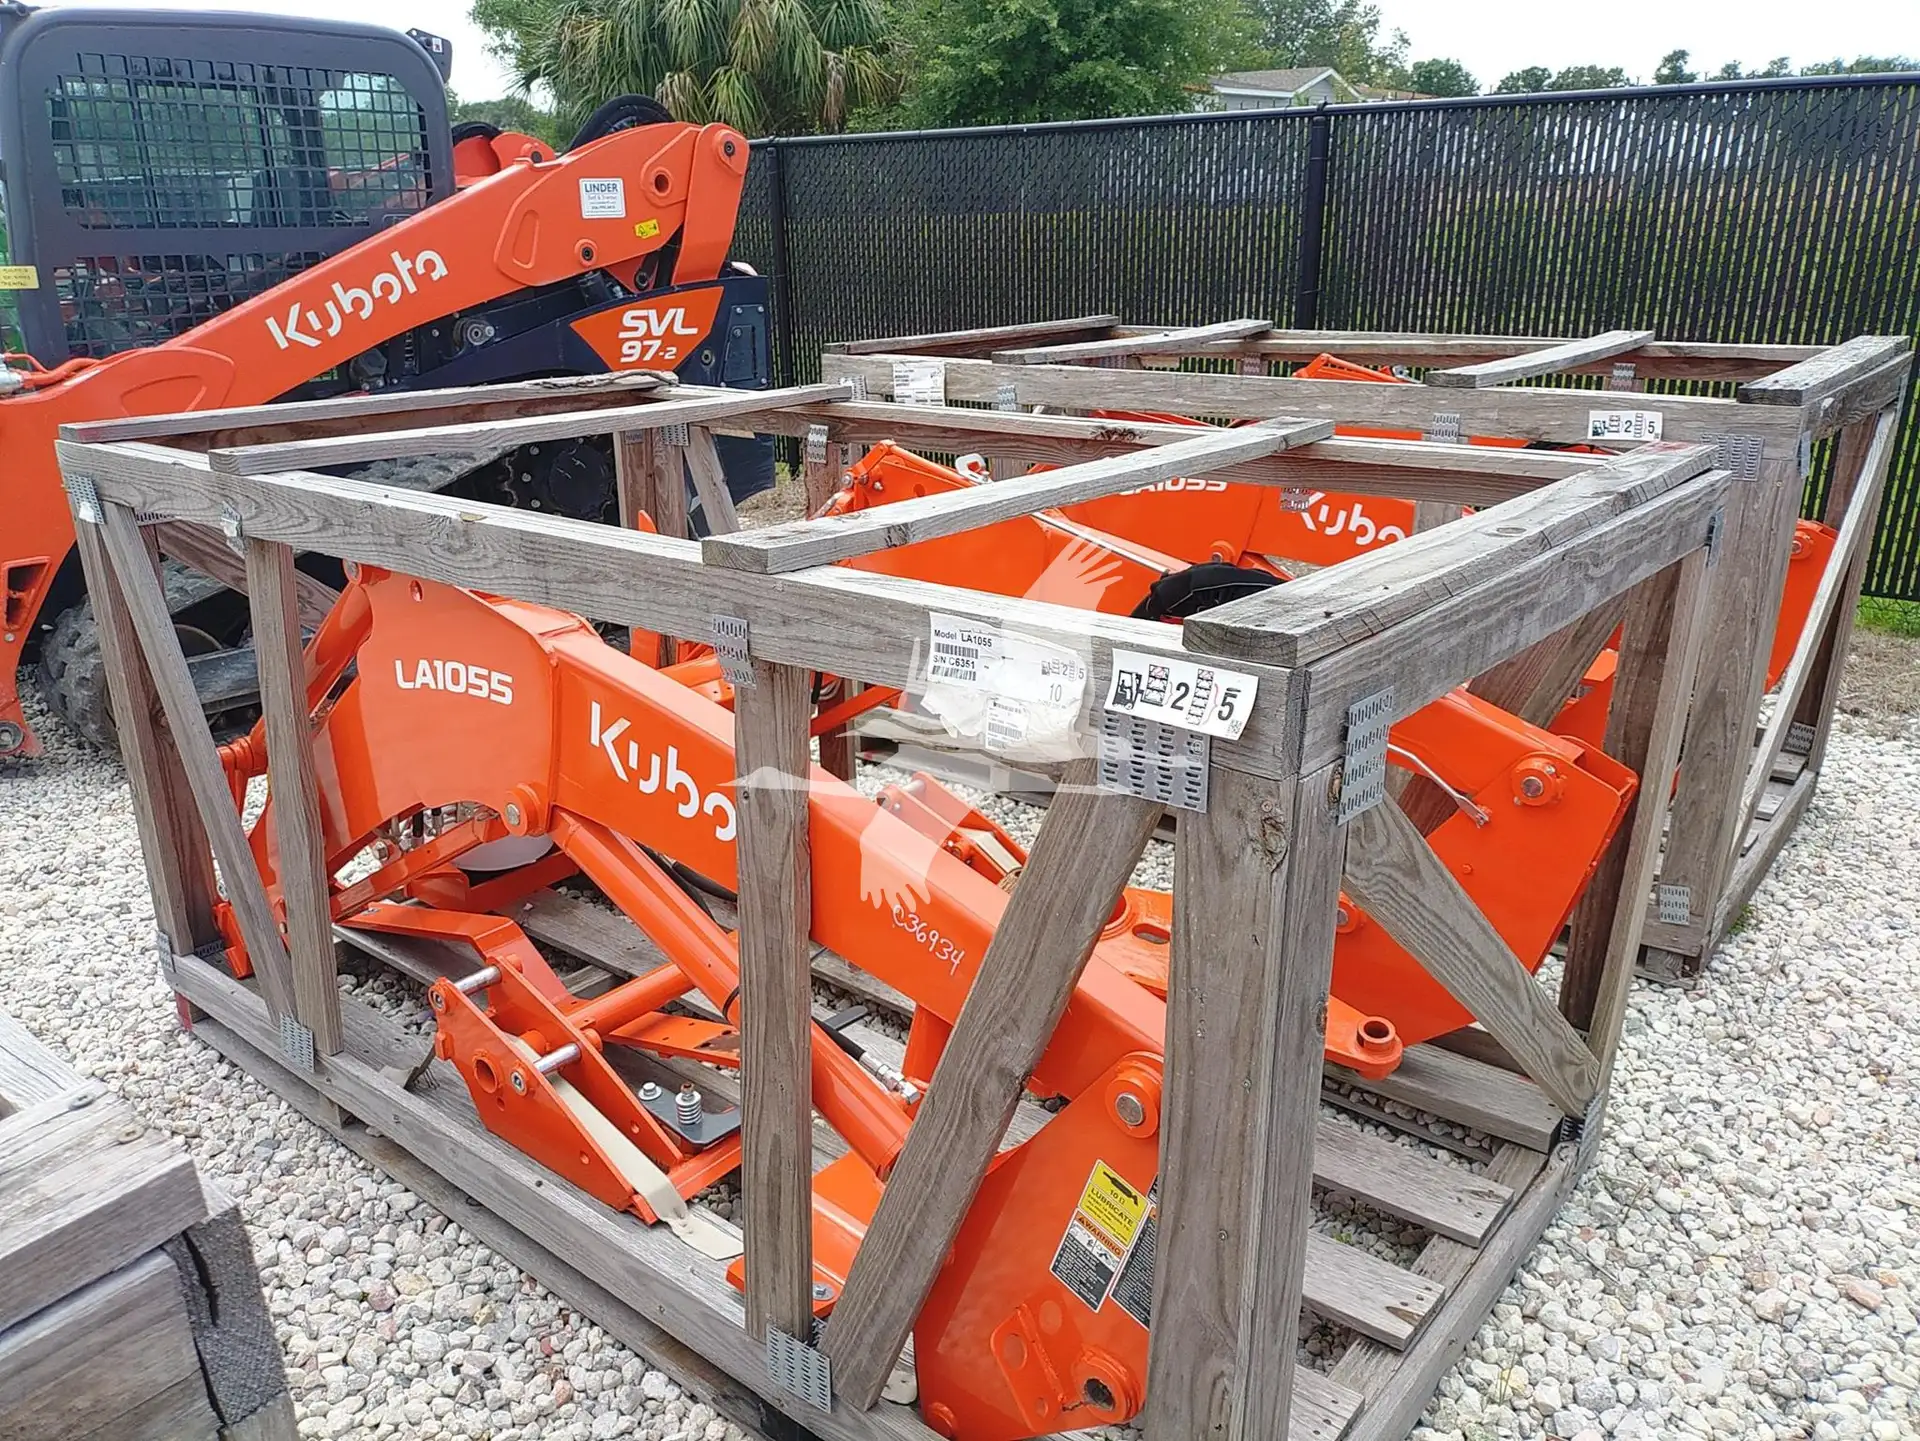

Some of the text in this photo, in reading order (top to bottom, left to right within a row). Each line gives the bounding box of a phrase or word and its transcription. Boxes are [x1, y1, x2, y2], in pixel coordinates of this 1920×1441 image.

[584, 182, 618, 193] LINDER
[264, 249, 449, 350] Kubota
[618, 307, 699, 339] SVL
[620, 339, 677, 363] 97-2
[1624, 420, 1655, 434] 2 5
[1290, 491, 1406, 546] Kubo
[934, 629, 992, 648] Model LA1055
[949, 656, 975, 670] C6351
[1062, 664, 1085, 680] 2 5
[395, 659, 514, 706] LA1055
[1050, 683, 1062, 702] 10
[1170, 681, 1238, 721] 2 5
[590, 700, 736, 842] Kubo
[1091, 1187, 1133, 1227] LUBRICATE
[1110, 1190, 1119, 1199] 10
[1085, 1220, 1121, 1256] WARNING
